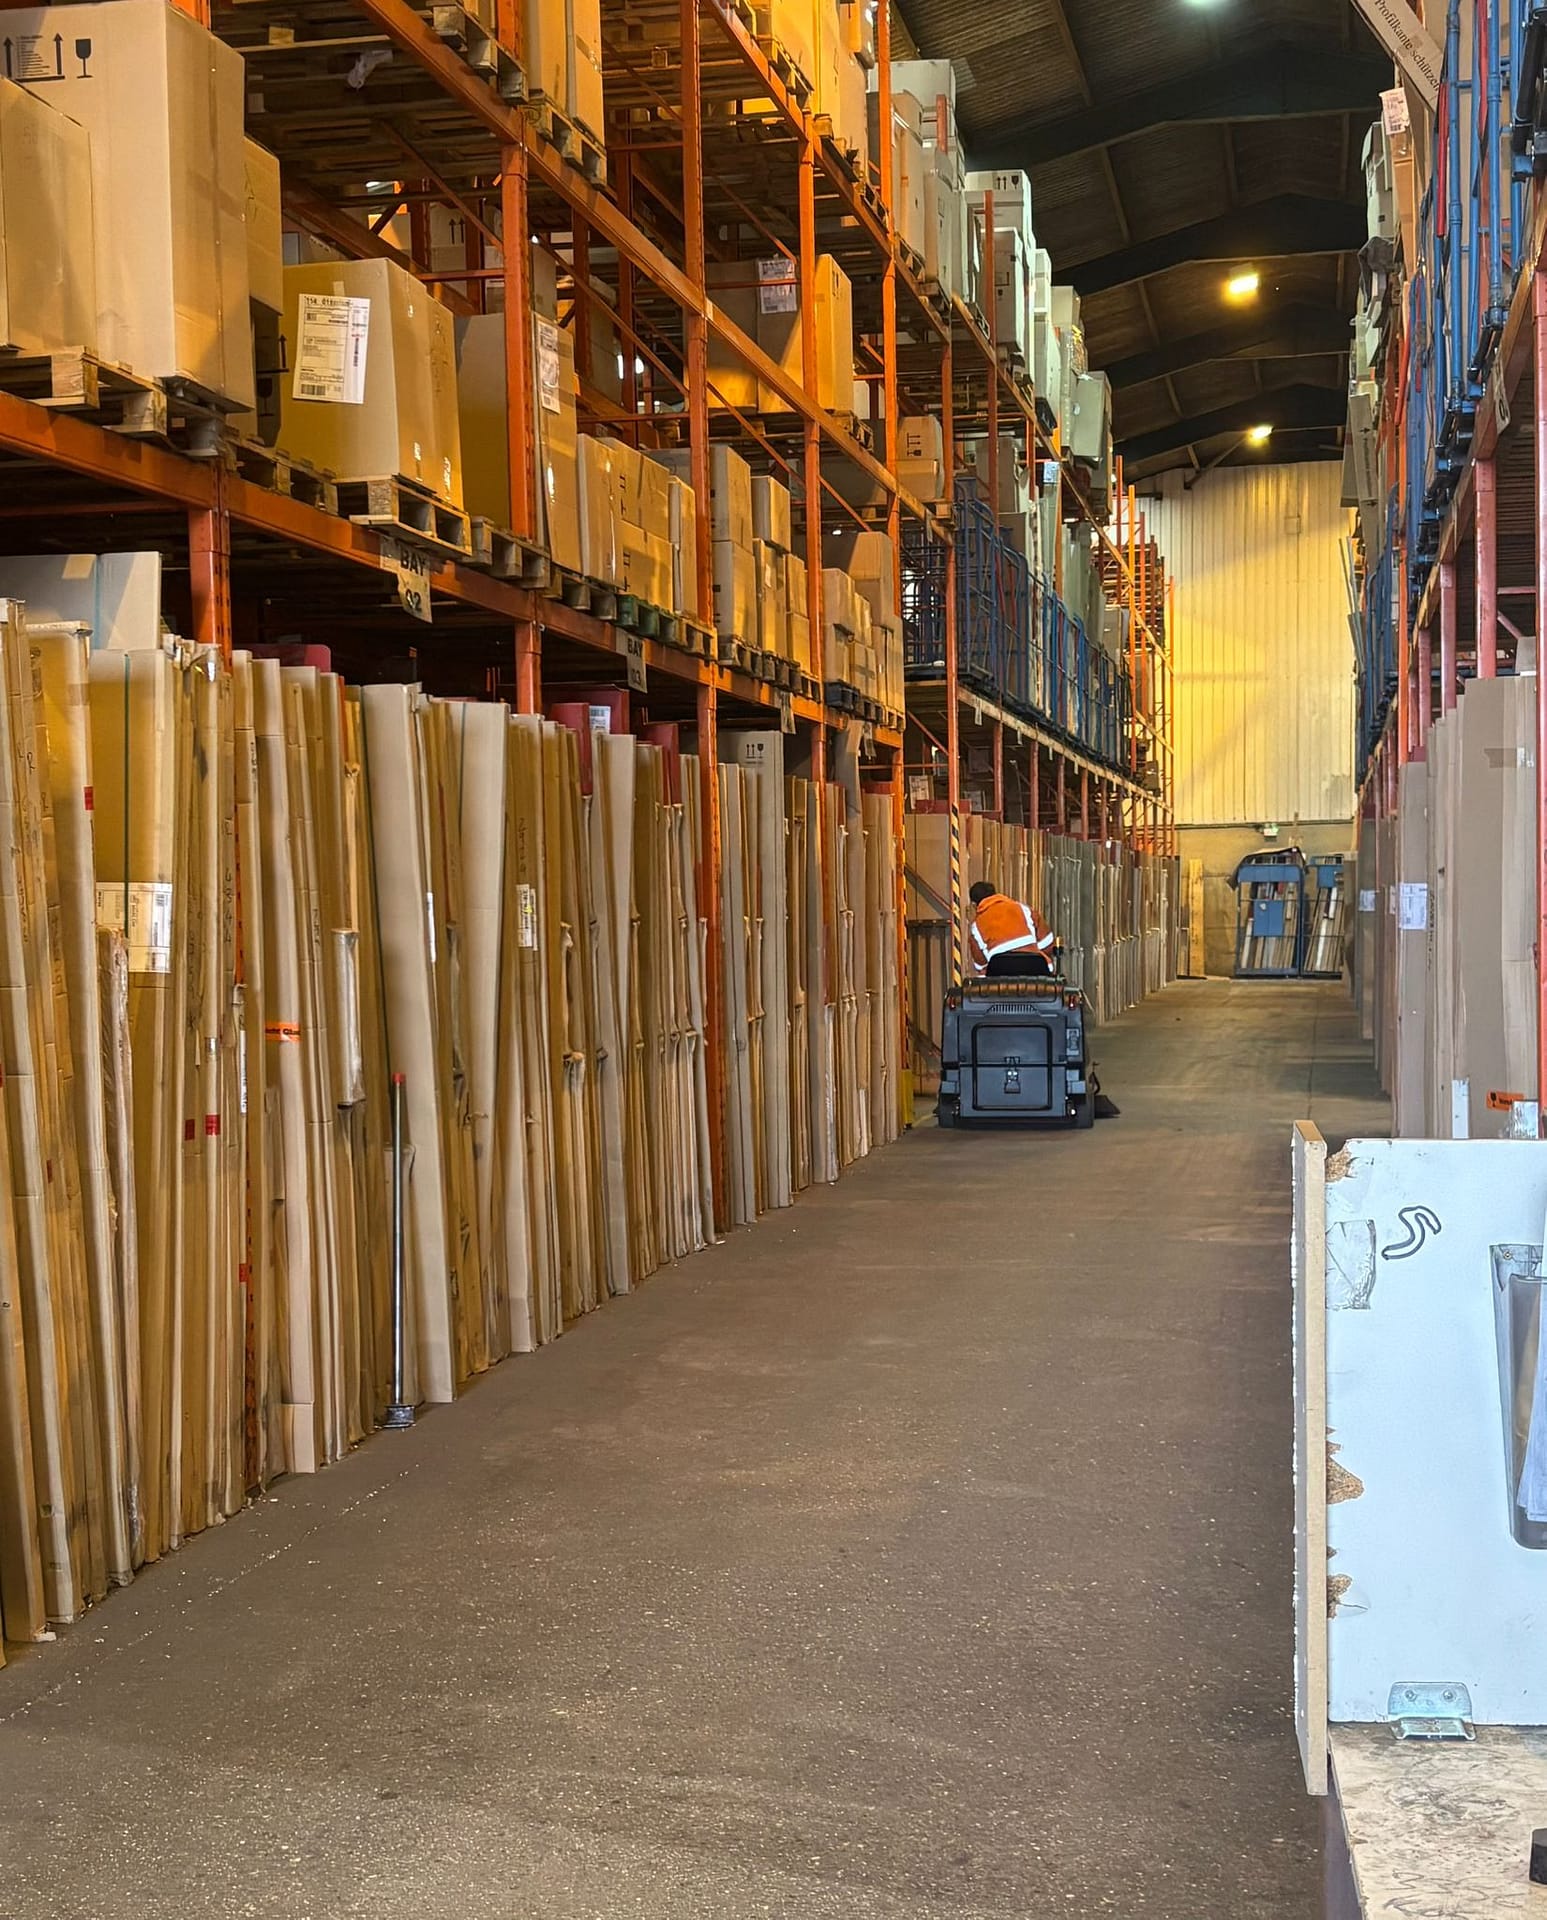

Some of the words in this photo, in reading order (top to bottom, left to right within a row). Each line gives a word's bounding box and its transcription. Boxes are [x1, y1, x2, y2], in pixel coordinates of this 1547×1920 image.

[1374, 0, 1413, 50] Profilkante
[400, 549, 425, 577] BAY
[627, 638, 643, 658] BAY
